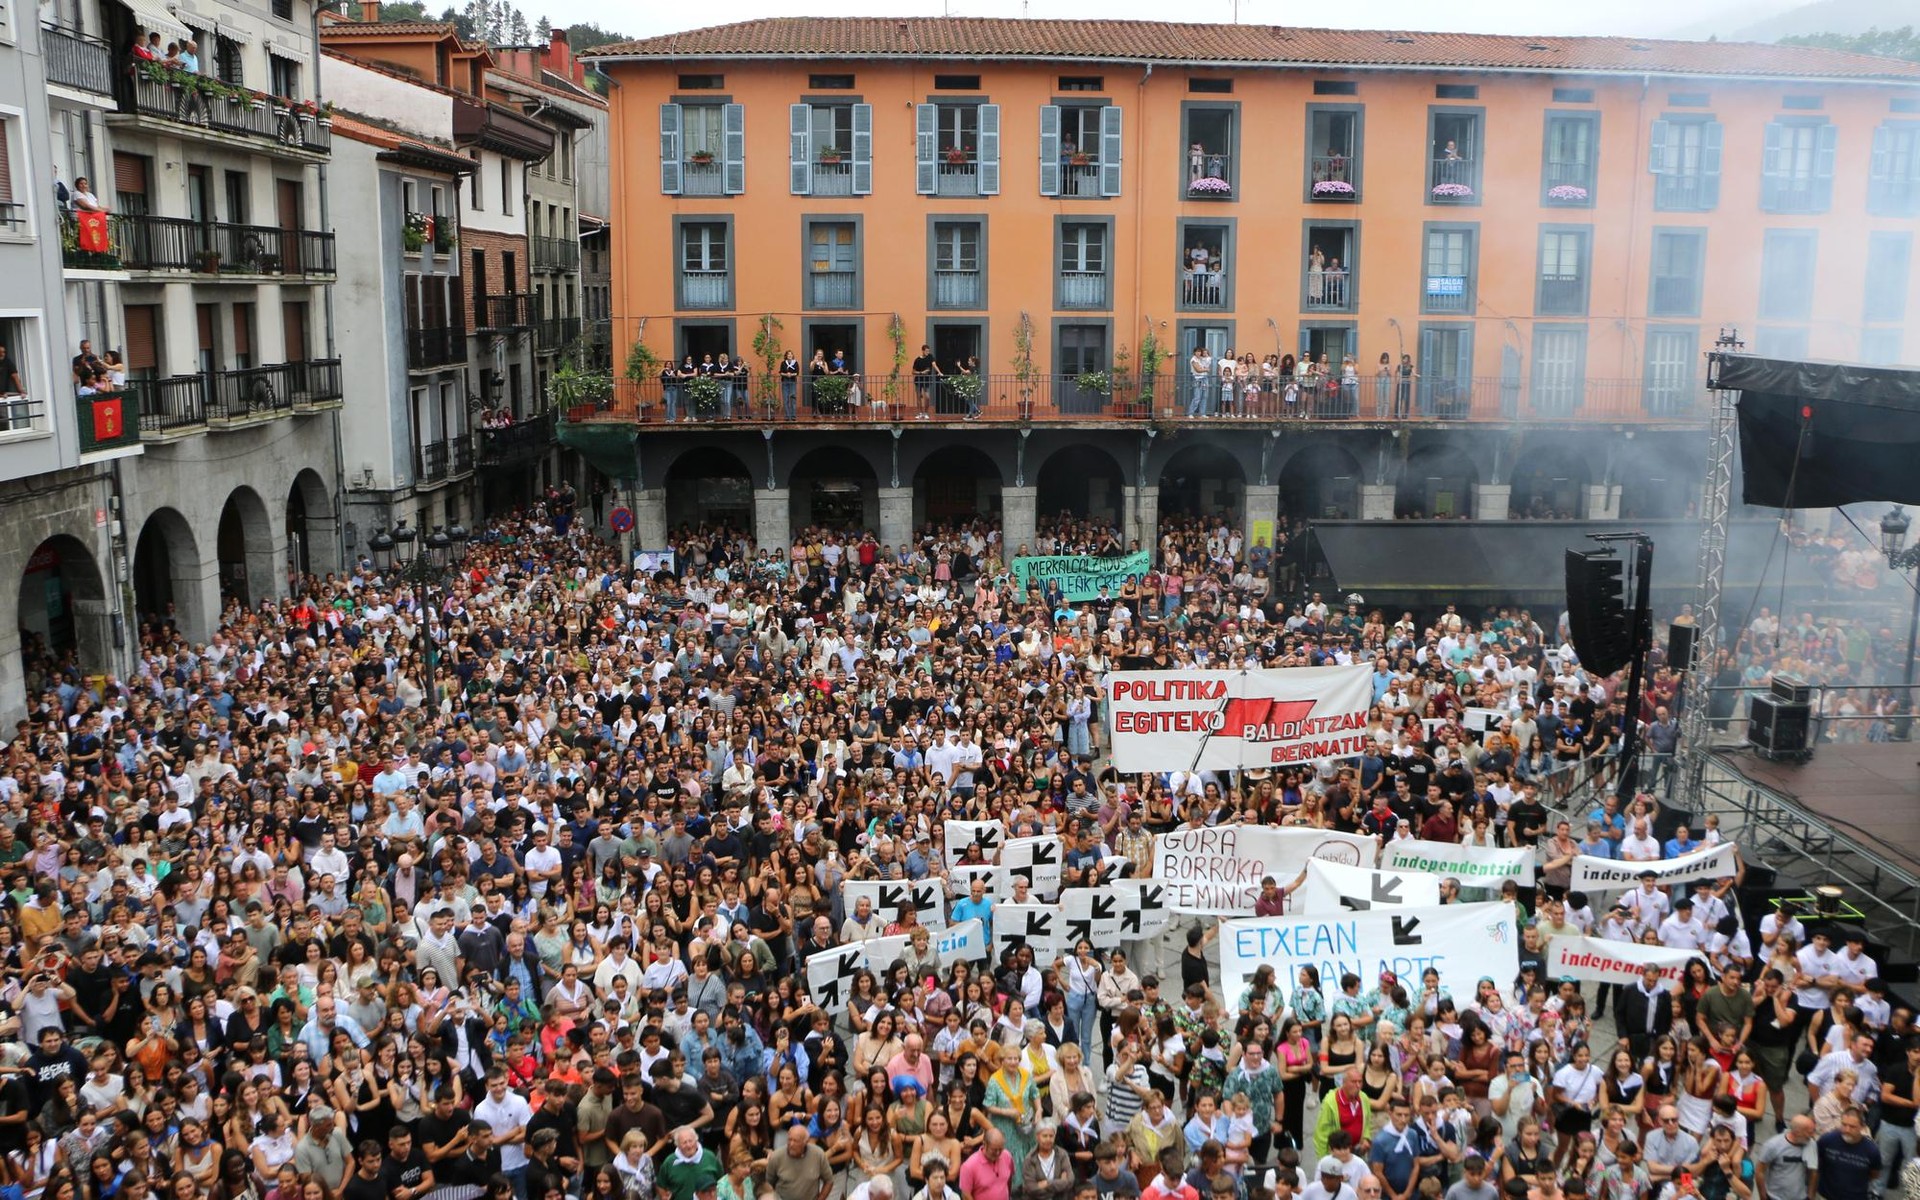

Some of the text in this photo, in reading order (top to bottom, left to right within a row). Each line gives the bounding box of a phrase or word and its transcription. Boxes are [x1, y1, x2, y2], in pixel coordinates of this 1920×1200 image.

[1113, 680, 1227, 701] POLITIKA
[1116, 710, 1226, 734] EGITEKO
[1242, 710, 1367, 742] BALDINTZAK
[1271, 735, 1368, 763] BERMATU
[1163, 829, 1236, 856] GORA
[1164, 854, 1264, 884] BORROKA
[1392, 852, 1523, 876] independentzia
[1583, 857, 1718, 882] indepedentzia
[1236, 921, 1357, 957] ETXEAN
